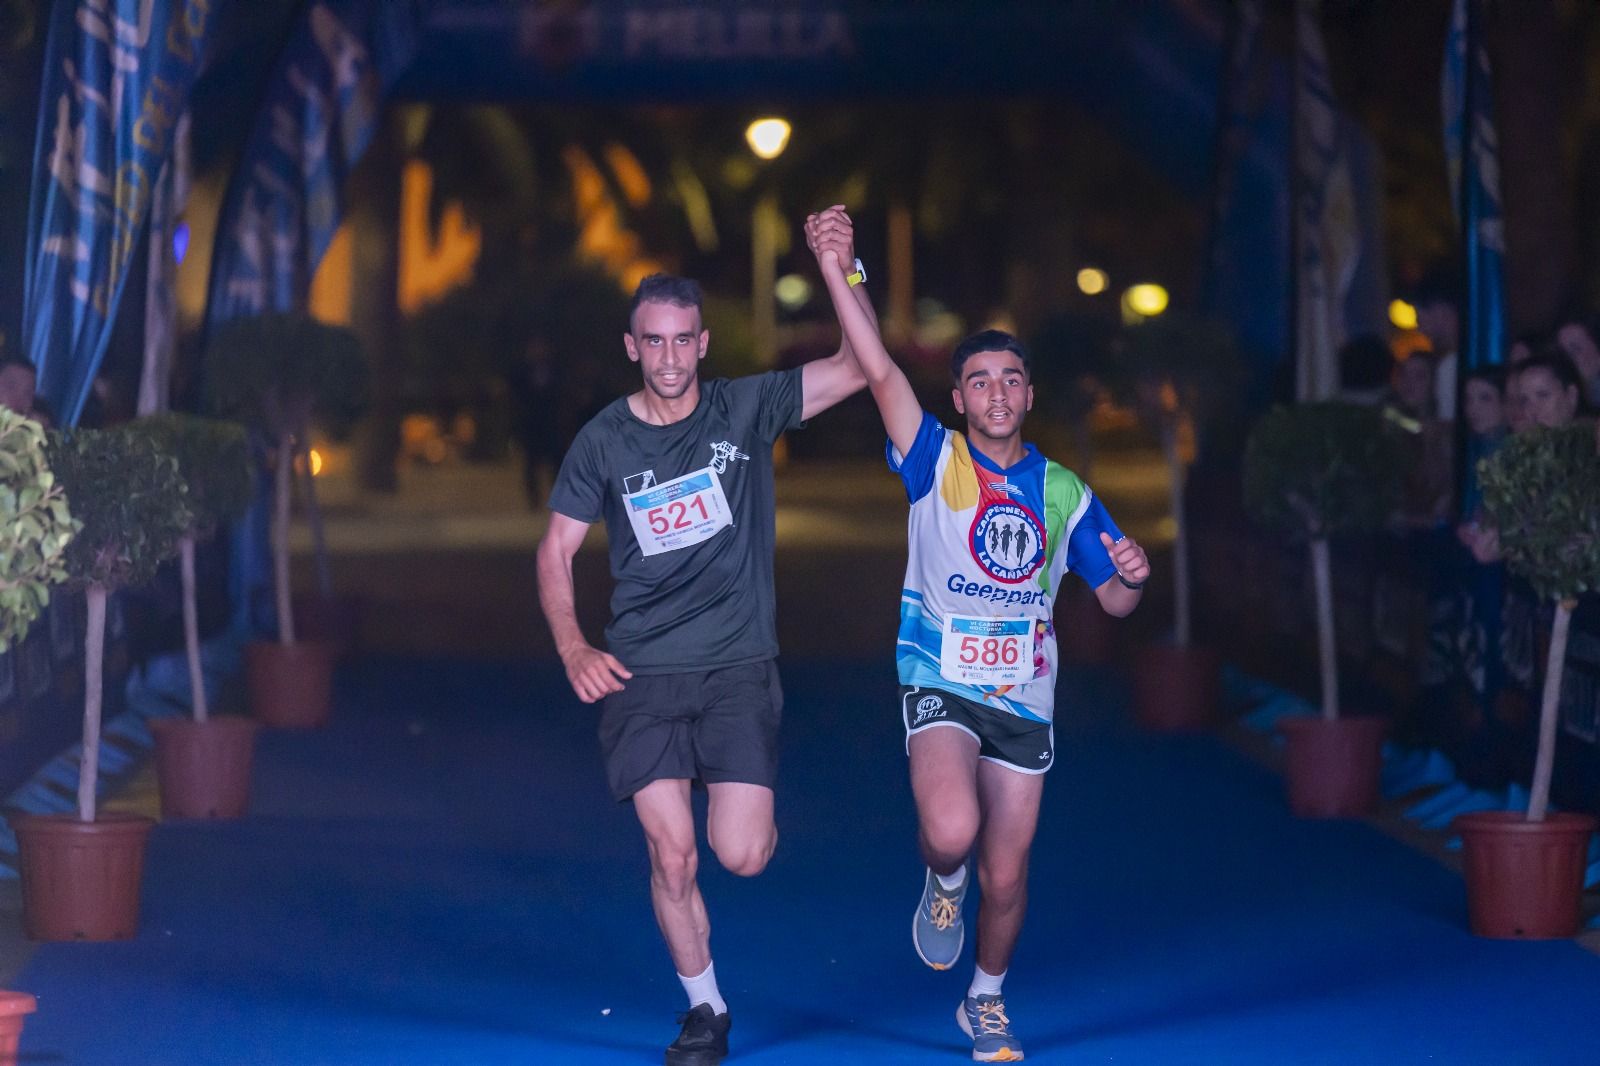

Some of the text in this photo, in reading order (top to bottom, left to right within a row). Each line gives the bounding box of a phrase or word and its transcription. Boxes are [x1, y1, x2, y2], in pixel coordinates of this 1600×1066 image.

[648, 494, 708, 534] 521
[978, 551, 991, 568] LA
[959, 636, 1018, 665] 586
